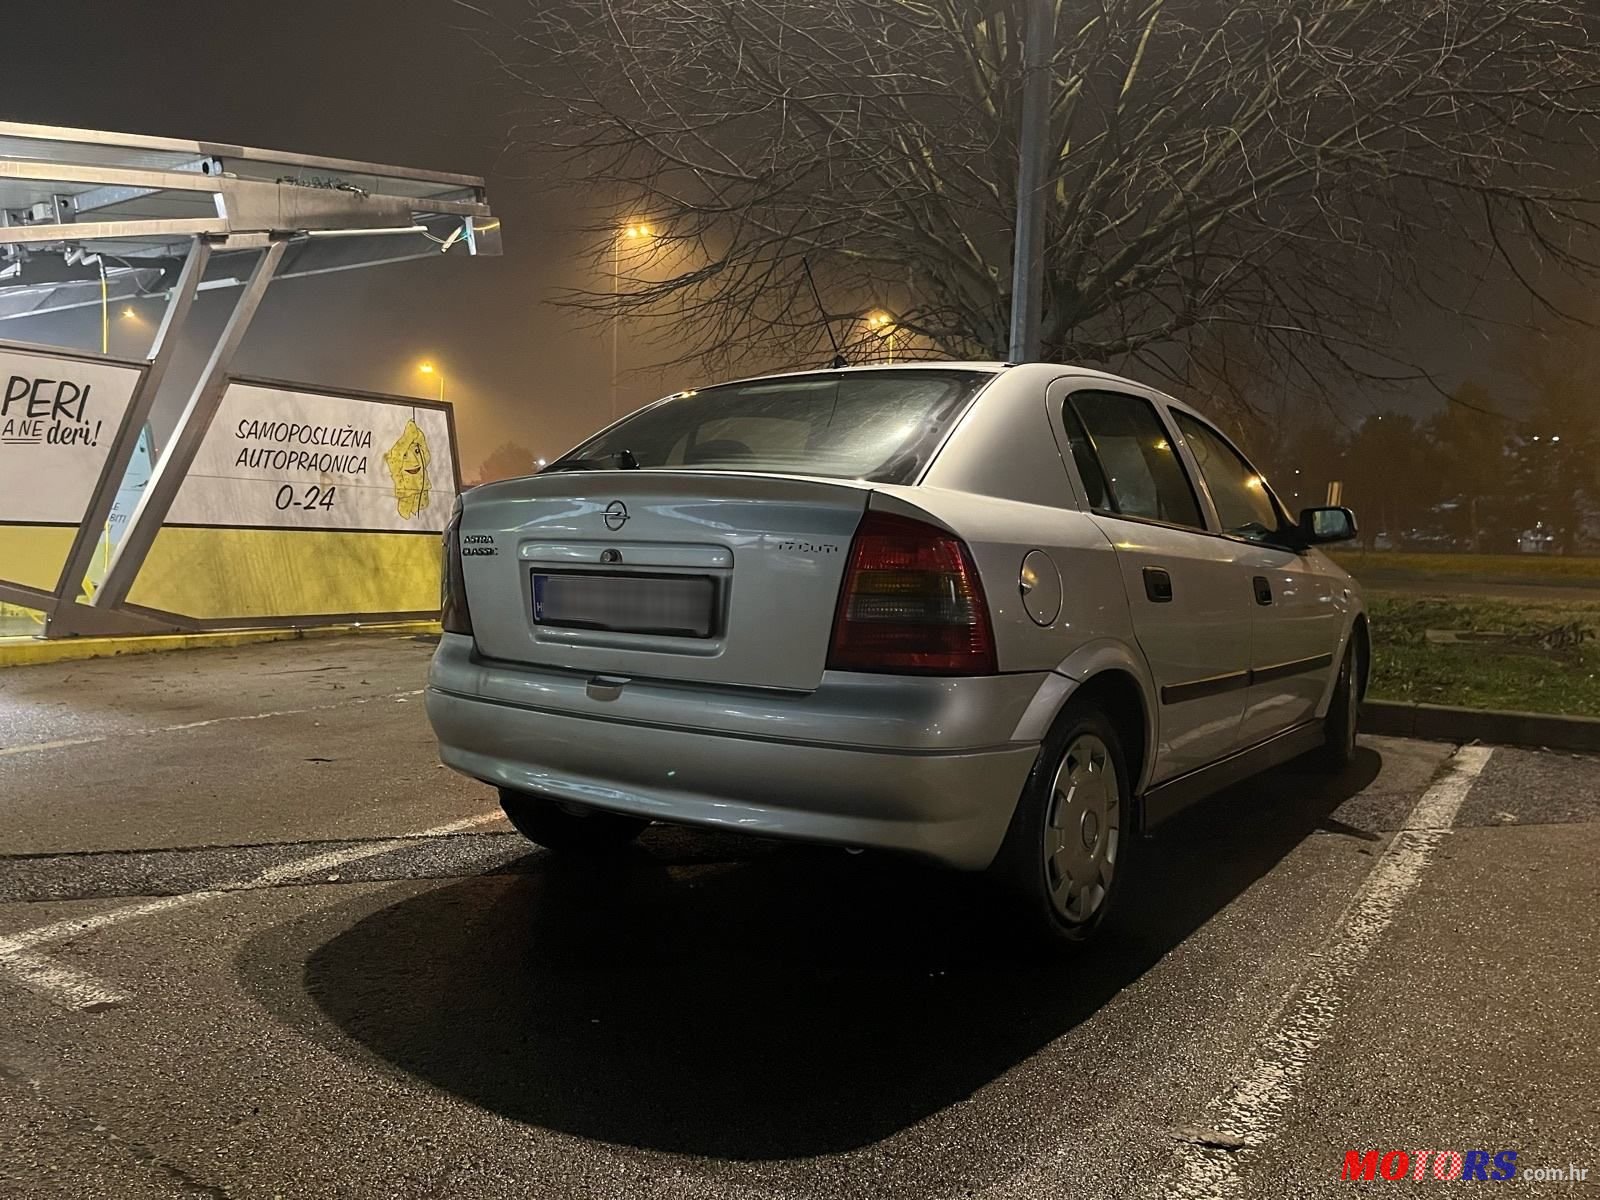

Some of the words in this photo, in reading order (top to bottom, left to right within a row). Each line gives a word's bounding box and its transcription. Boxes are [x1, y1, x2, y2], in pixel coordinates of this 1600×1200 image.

[1, 375, 91, 423] PERI
[2, 418, 14, 436] A
[18, 419, 45, 437] NE
[46, 419, 102, 447] deri!
[235, 419, 372, 448] SAMOPOSLUŽNA
[235, 447, 367, 474] AUTOPRAONICA
[275, 484, 336, 511] 0-24
[462, 547, 499, 556] CLASSIC
[463, 535, 494, 544] ASTRA
